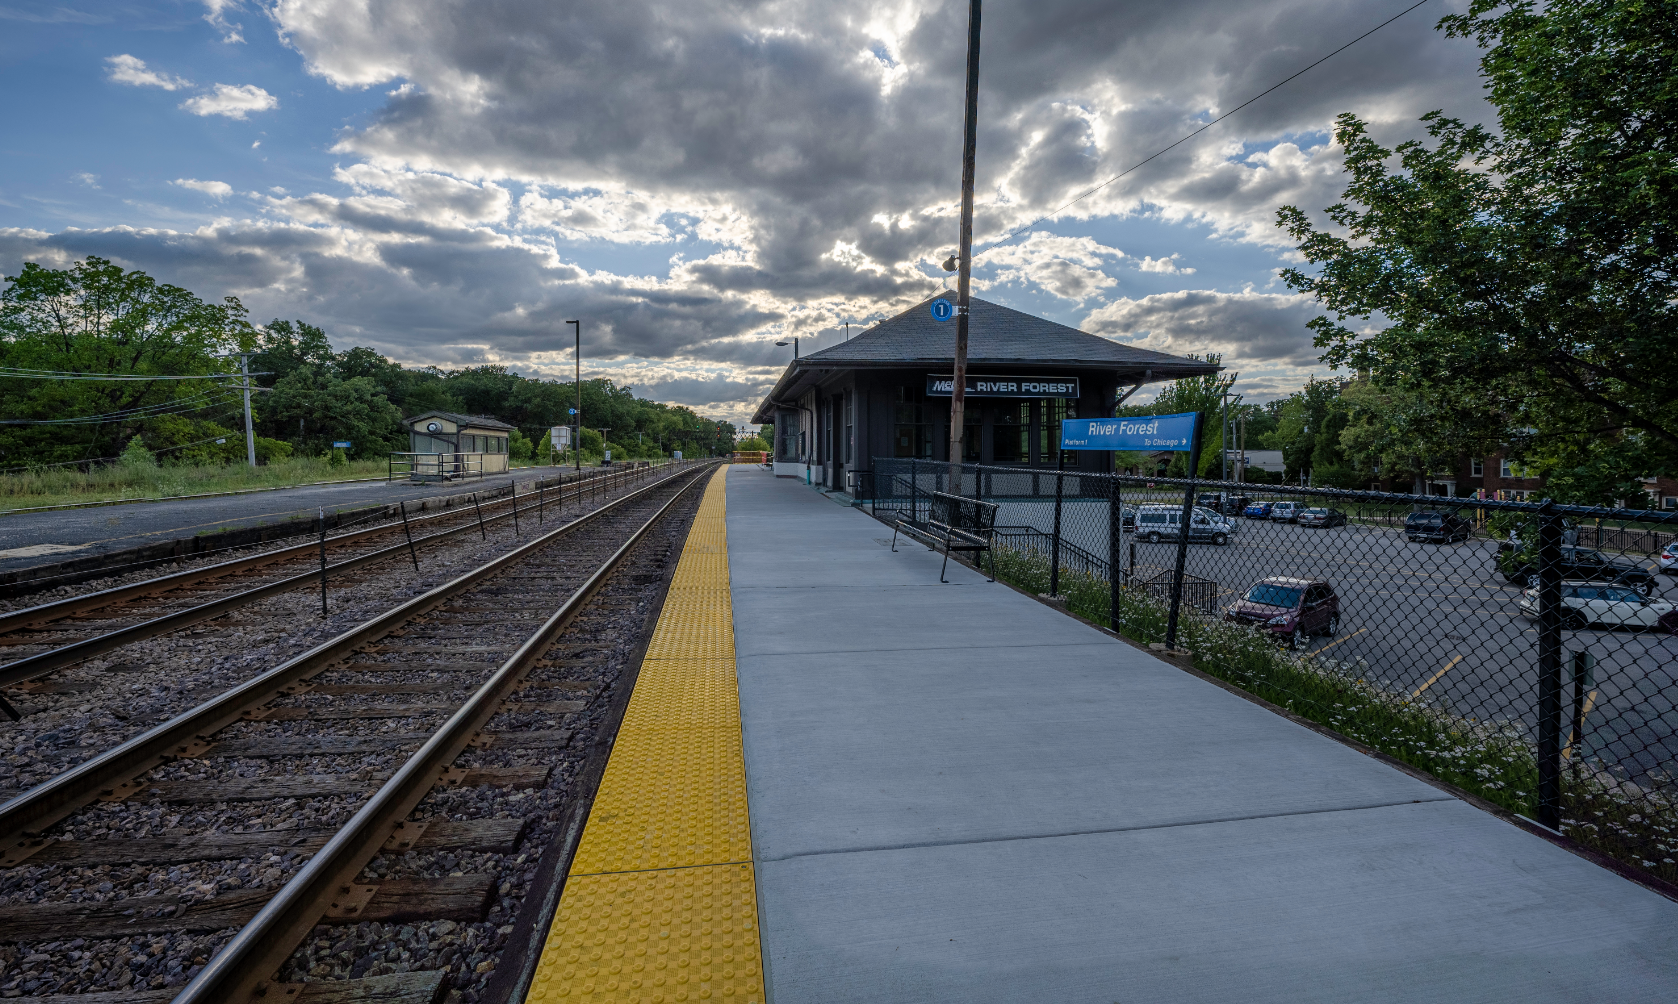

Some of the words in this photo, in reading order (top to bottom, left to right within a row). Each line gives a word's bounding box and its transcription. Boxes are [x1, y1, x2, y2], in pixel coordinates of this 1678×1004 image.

[938, 304, 944, 316] 1
[977, 381, 1018, 392] RIVER
[1021, 382, 1075, 393] FOREST
[1088, 422, 1117, 436] River
[1119, 421, 1159, 435] Forest
[1144, 438, 1151, 446] To
[1152, 438, 1179, 448] Chicago
